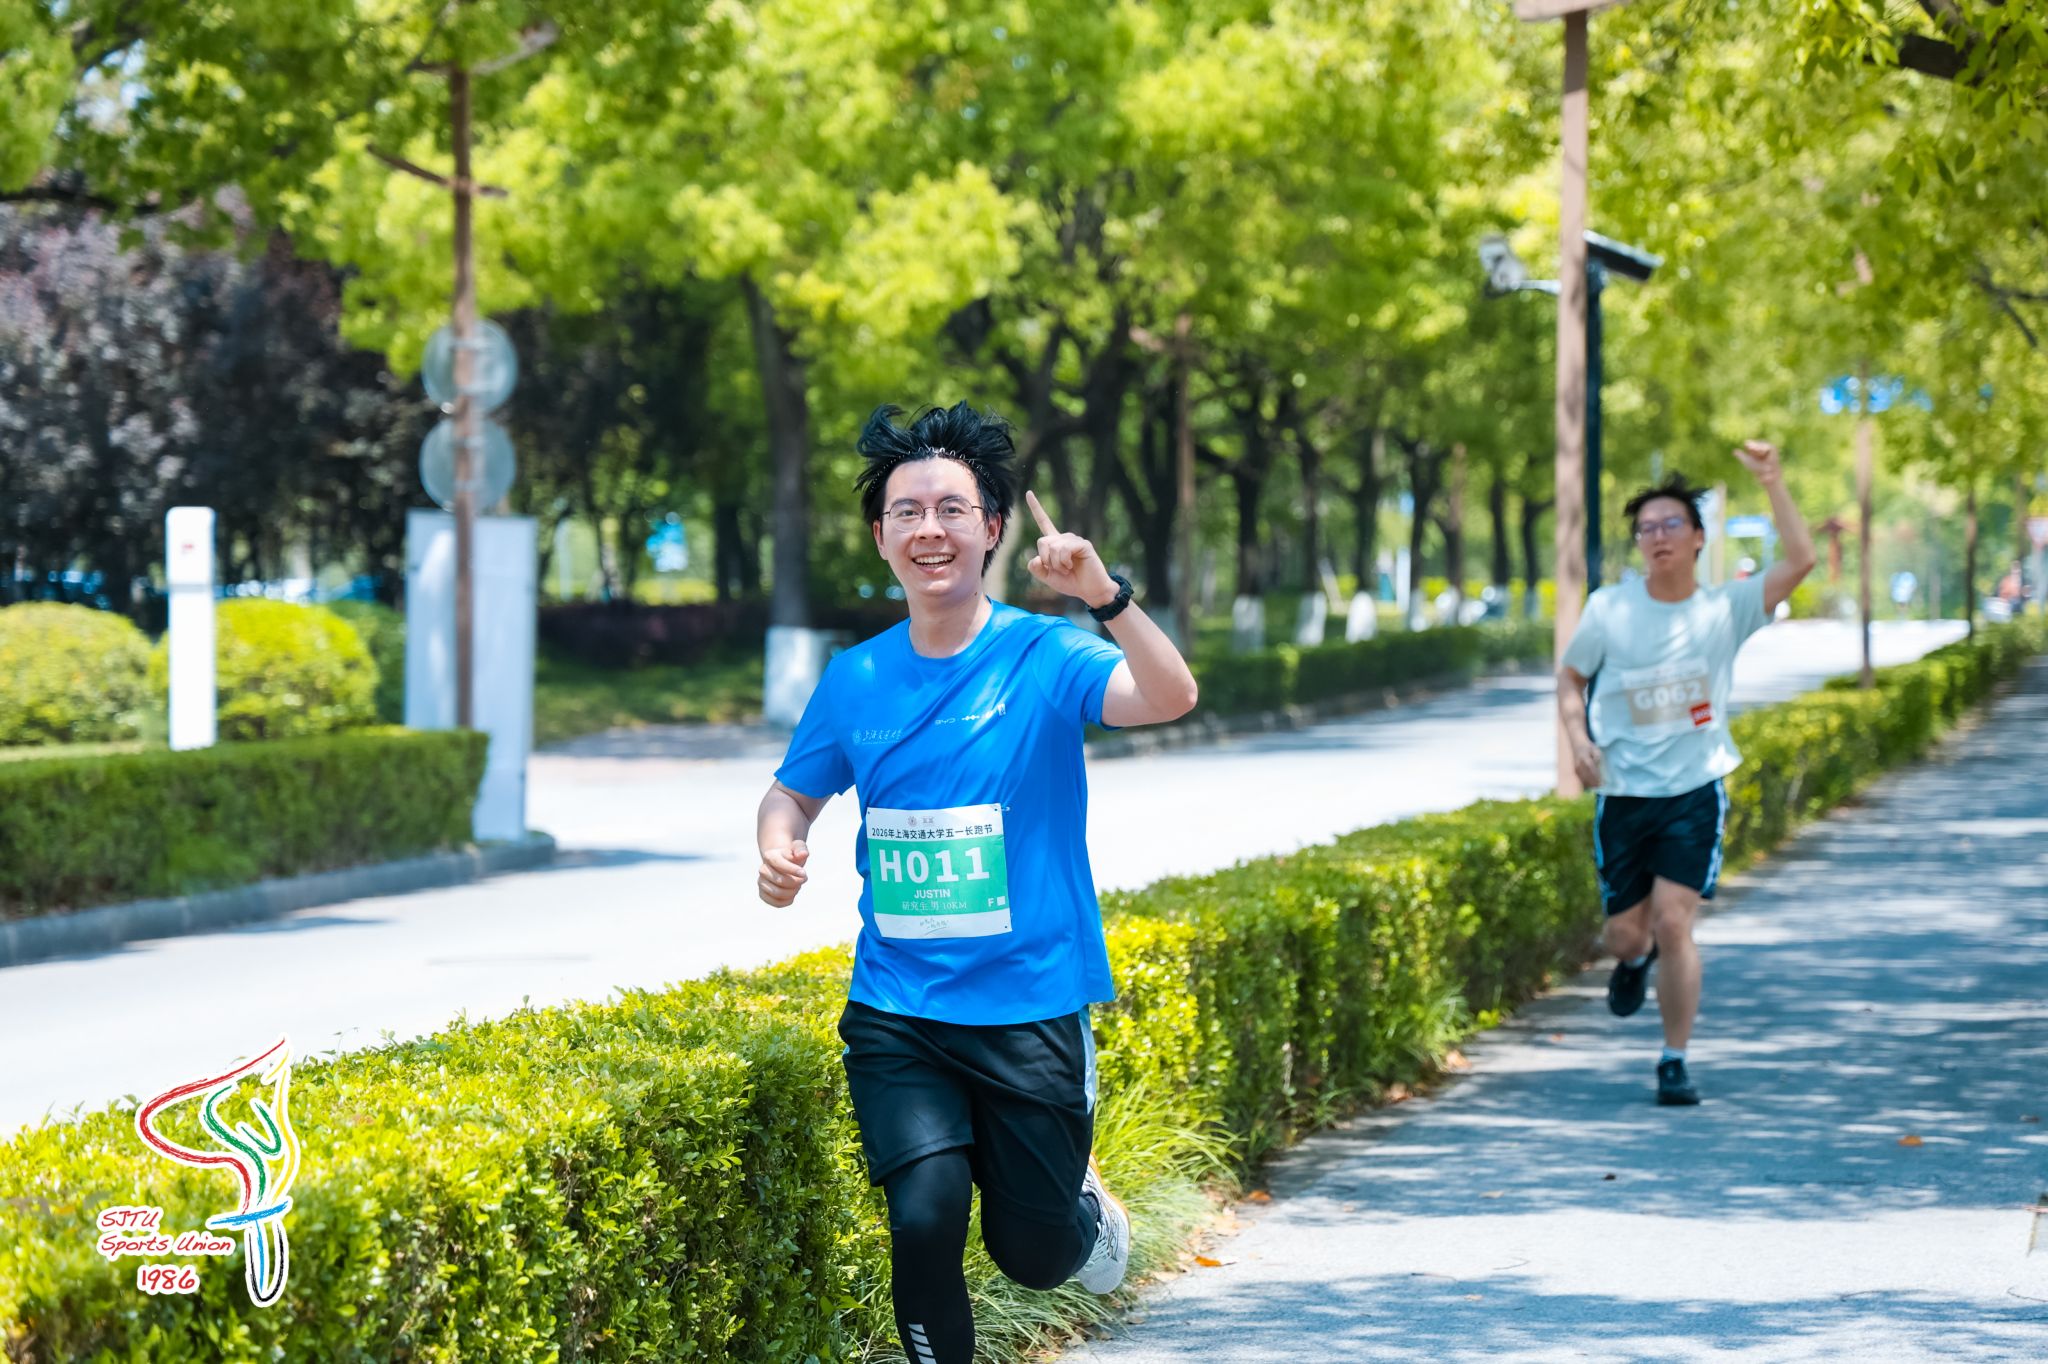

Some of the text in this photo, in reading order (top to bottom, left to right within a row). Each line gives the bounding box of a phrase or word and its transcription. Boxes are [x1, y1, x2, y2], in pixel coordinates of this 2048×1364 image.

[1634, 680, 1703, 710] G062
[872, 824, 993, 839] 2026年上海交通大学五一长跑节
[879, 847, 990, 884] H011
[914, 889, 951, 899] JUSTIN
[943, 902, 967, 910] 10KM
